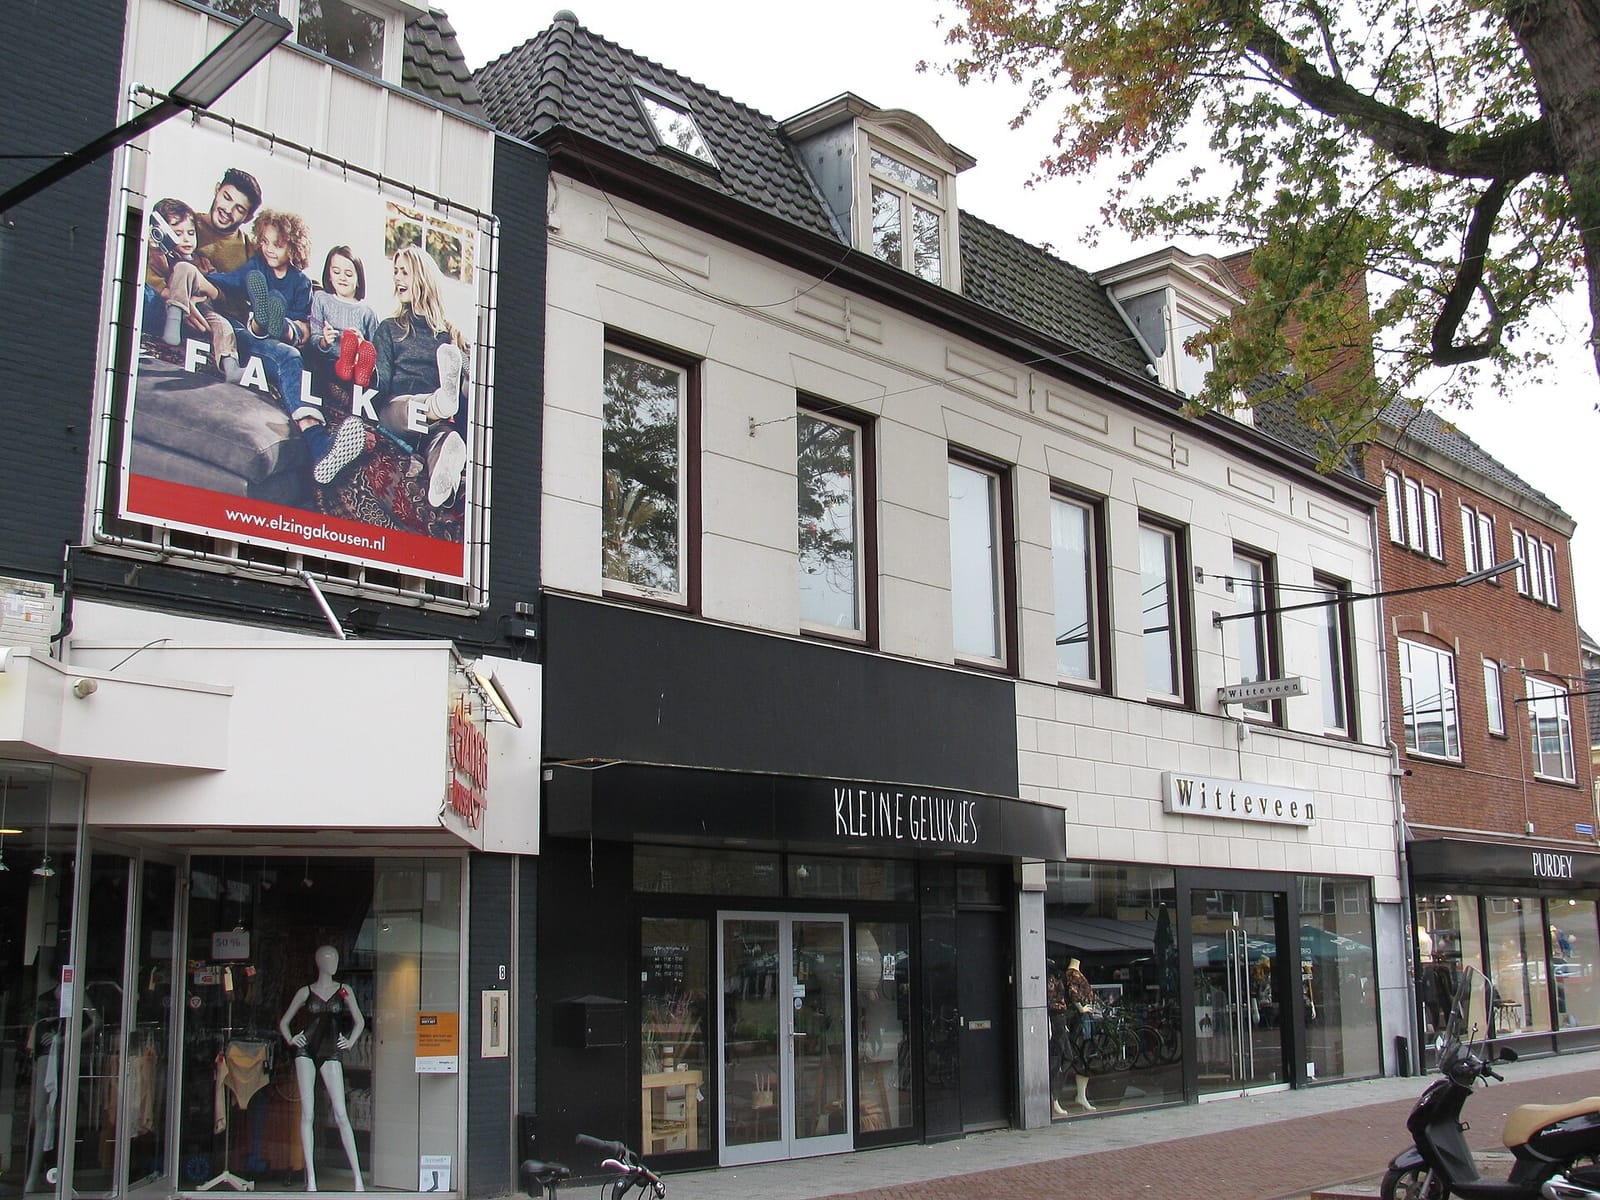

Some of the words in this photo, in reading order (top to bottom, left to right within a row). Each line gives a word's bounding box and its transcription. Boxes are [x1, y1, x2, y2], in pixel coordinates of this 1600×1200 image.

[184, 338, 429, 434] FALKE
[225, 509, 386, 551] www.elzingakousen.nl
[1228, 683, 1298, 698] Witteveen
[834, 787, 904, 839] KLEINE
[909, 794, 978, 845] GELUKJES
[1176, 778, 1314, 819] Witteveen
[1532, 852, 1572, 878] PURDEY
